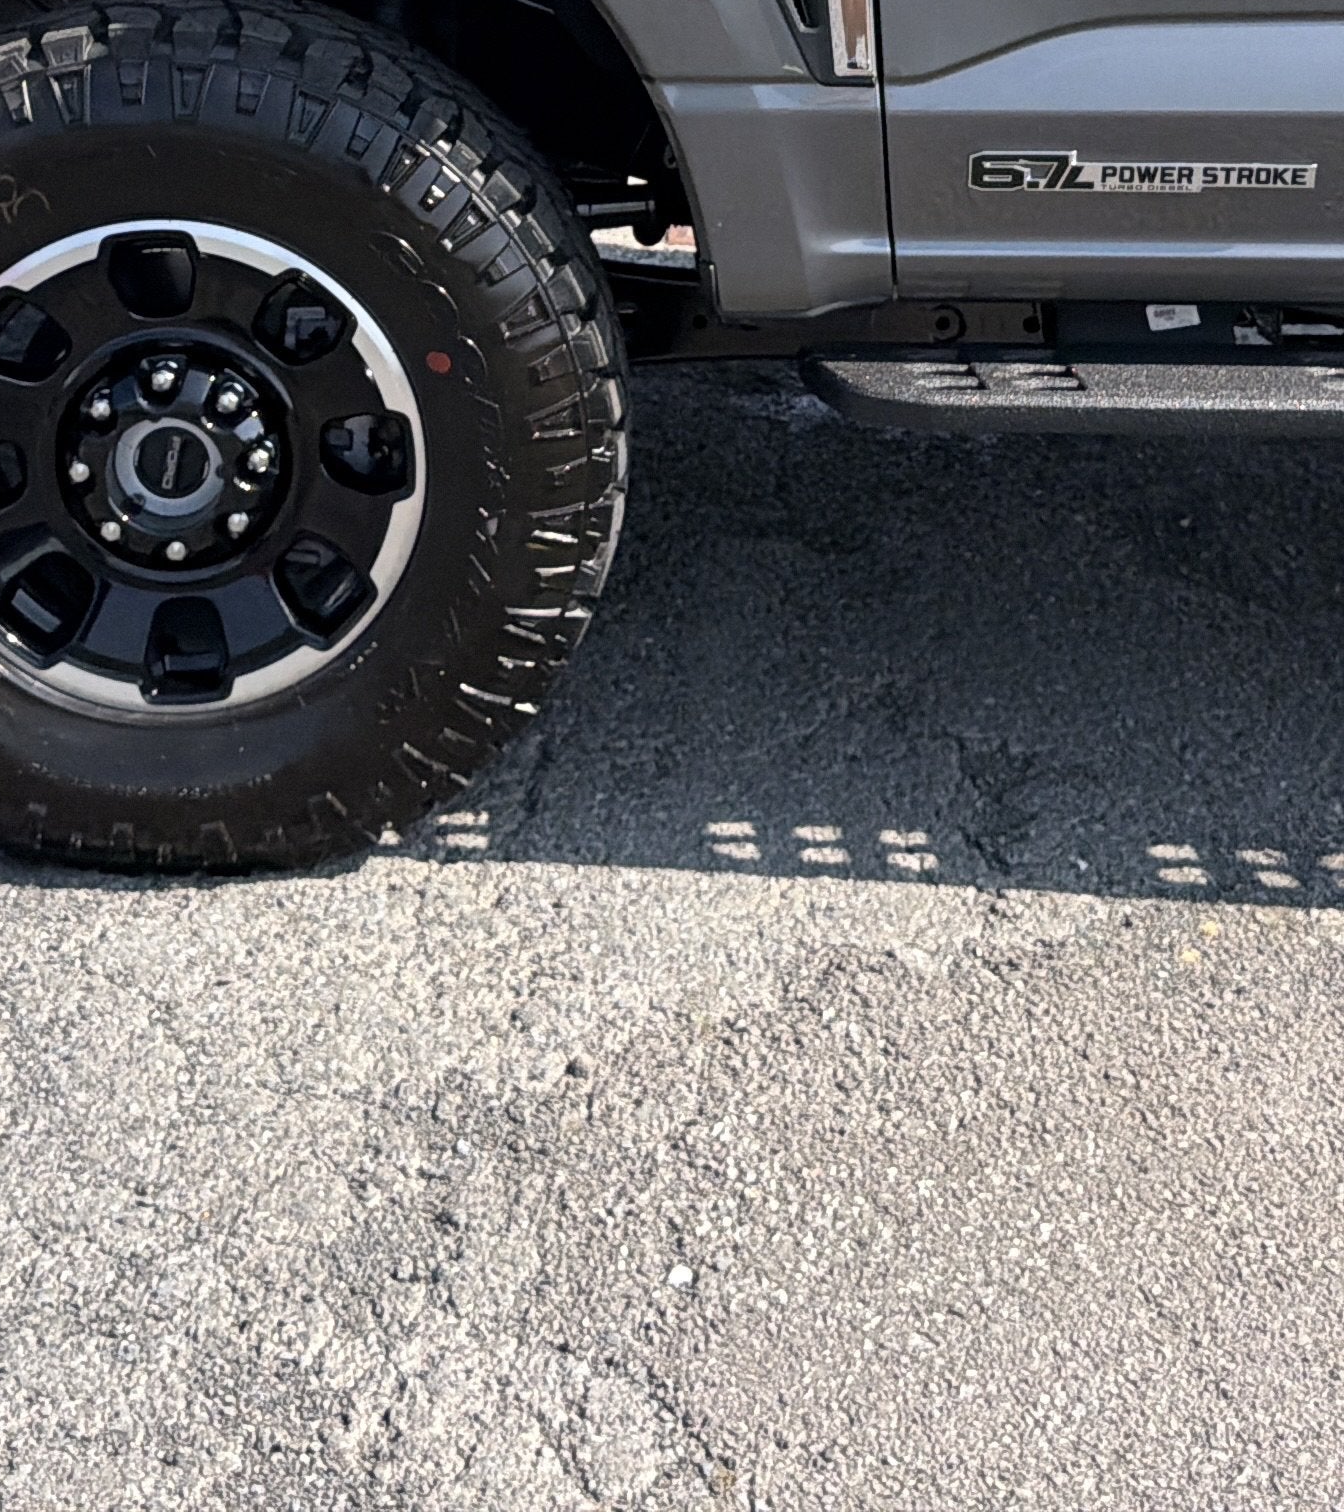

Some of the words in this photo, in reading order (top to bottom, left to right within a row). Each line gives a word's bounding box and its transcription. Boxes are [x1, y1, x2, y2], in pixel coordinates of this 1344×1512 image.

[969, 151, 1095, 191] 6.7L
[1101, 166, 1194, 184] POWER
[1201, 166, 1308, 186] STROKE
